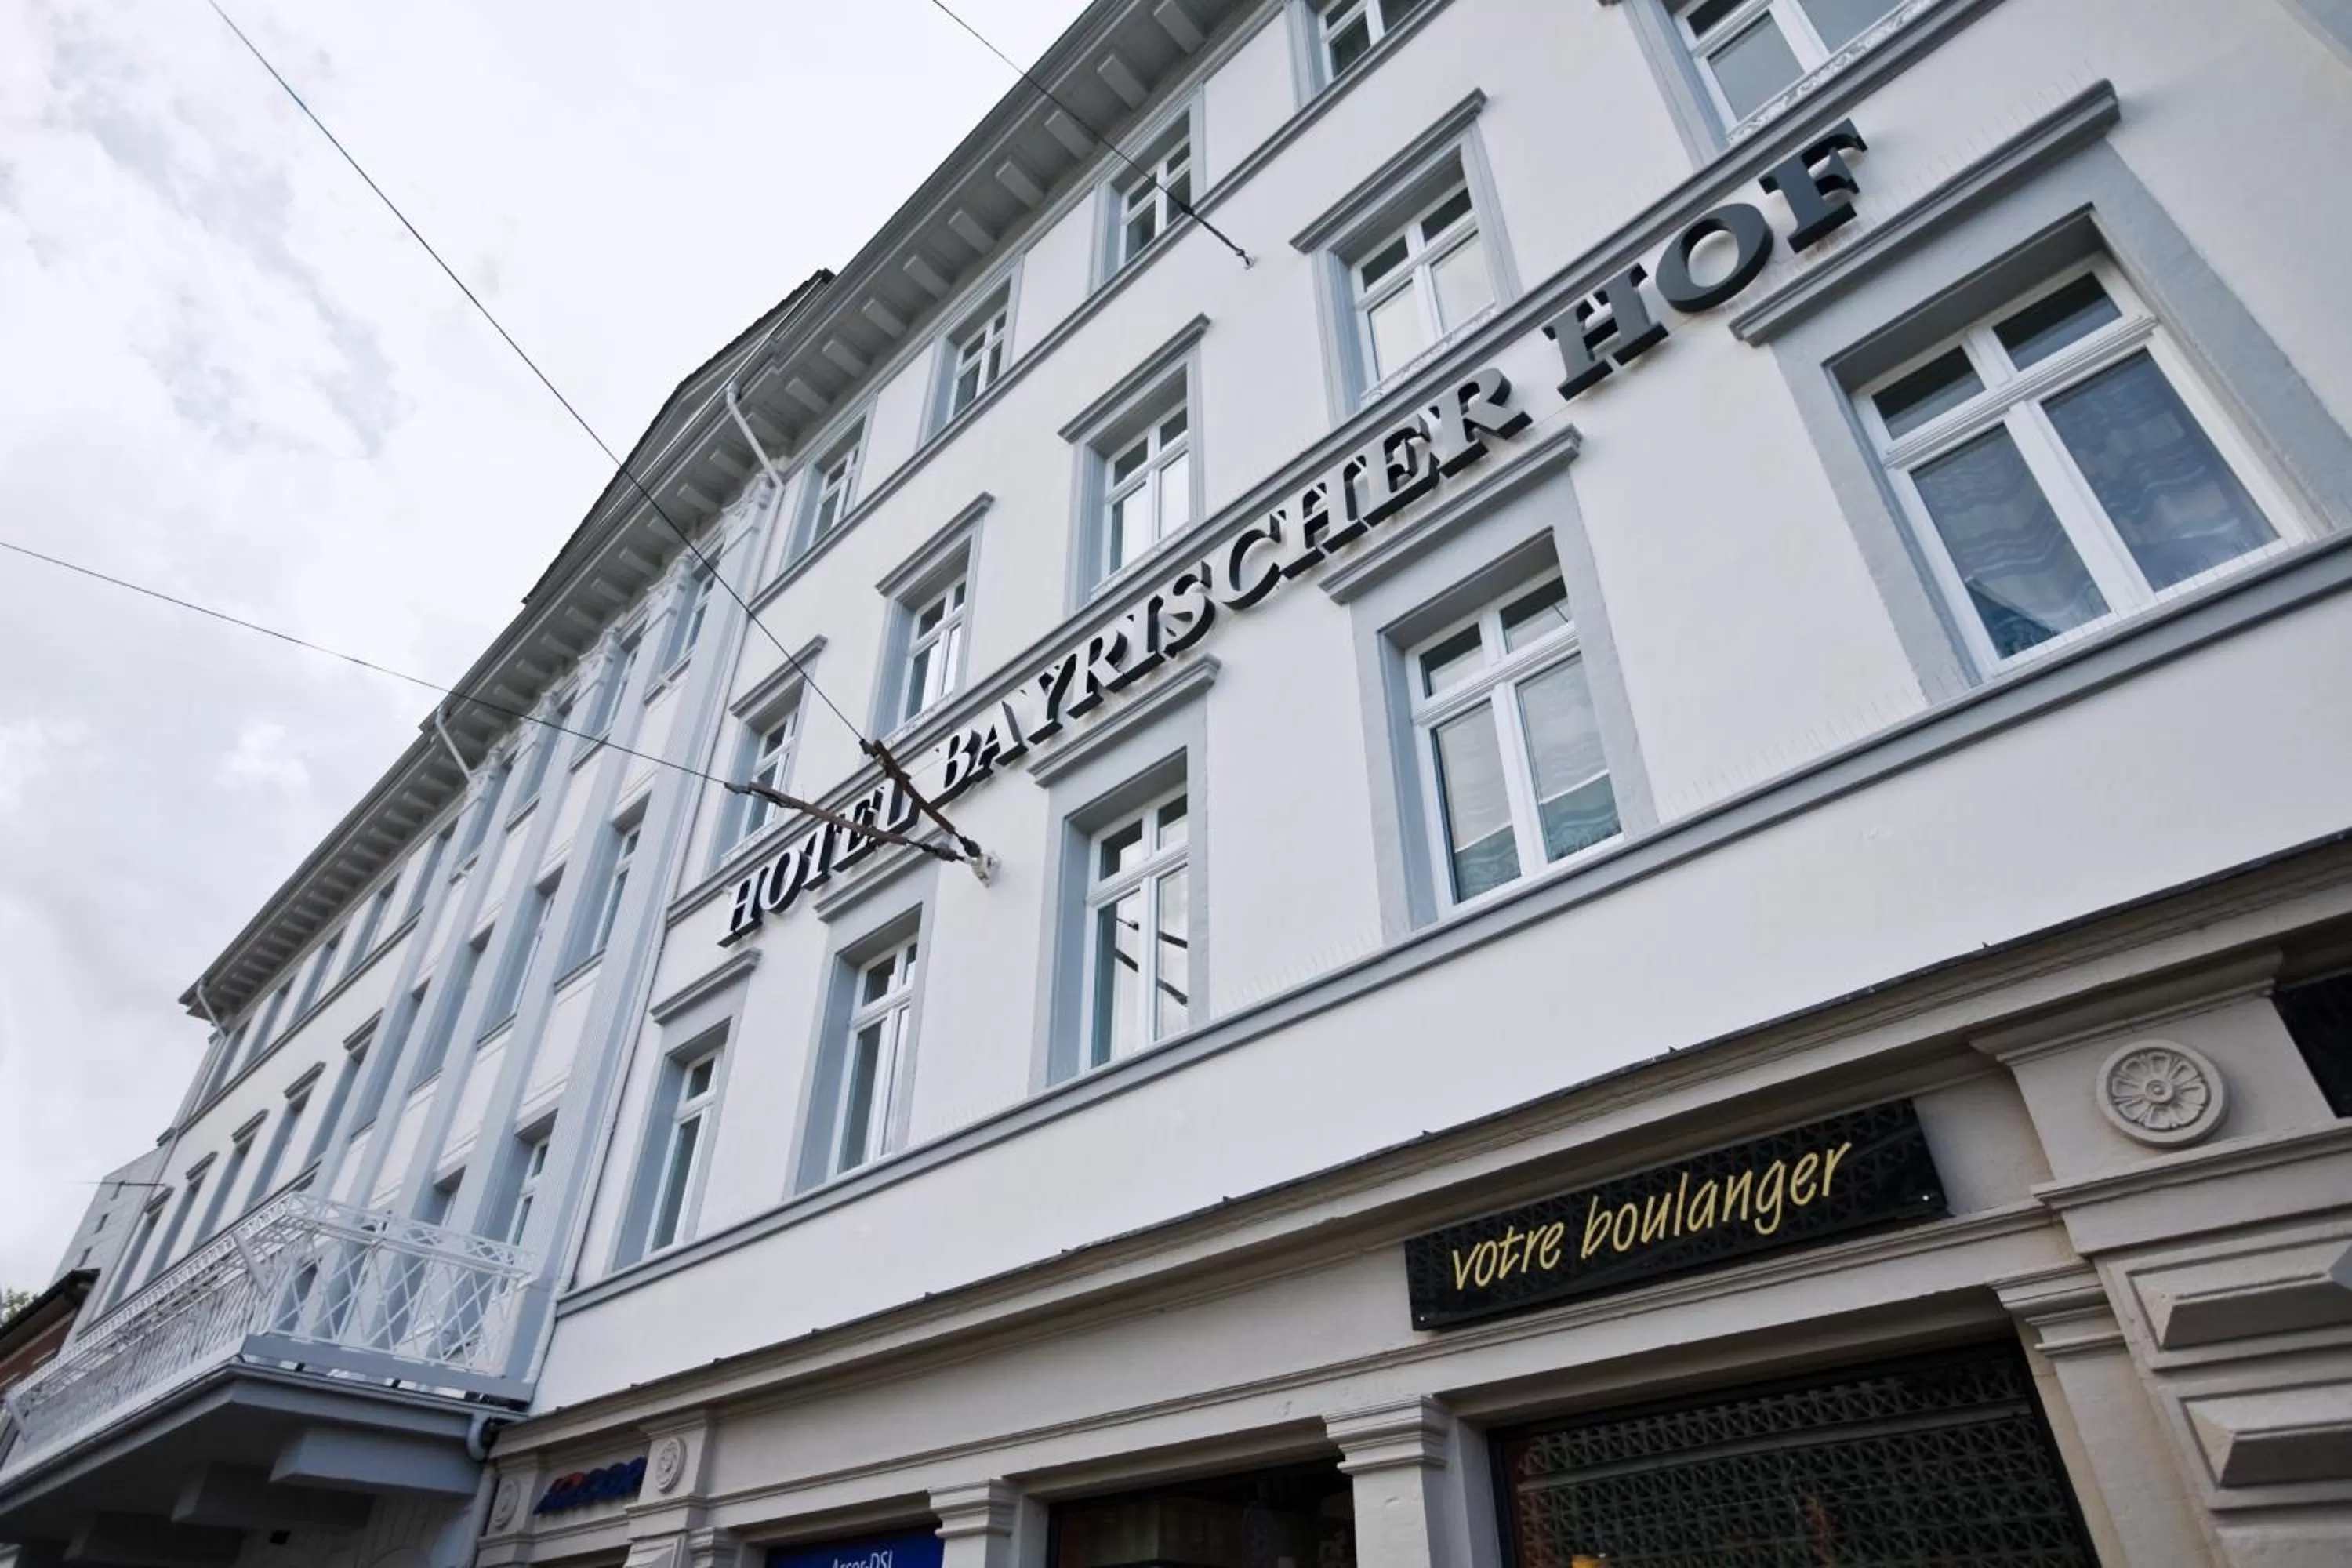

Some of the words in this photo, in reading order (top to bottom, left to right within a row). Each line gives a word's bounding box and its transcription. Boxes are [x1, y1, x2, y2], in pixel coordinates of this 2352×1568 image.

[717, 780, 922, 947] HOTEL
[931, 368, 1533, 811] BAYRISCHER
[1542, 118, 1868, 401] HOF
[1452, 1221, 1565, 1290] votre
[1580, 1142, 1852, 1260] boulanger
